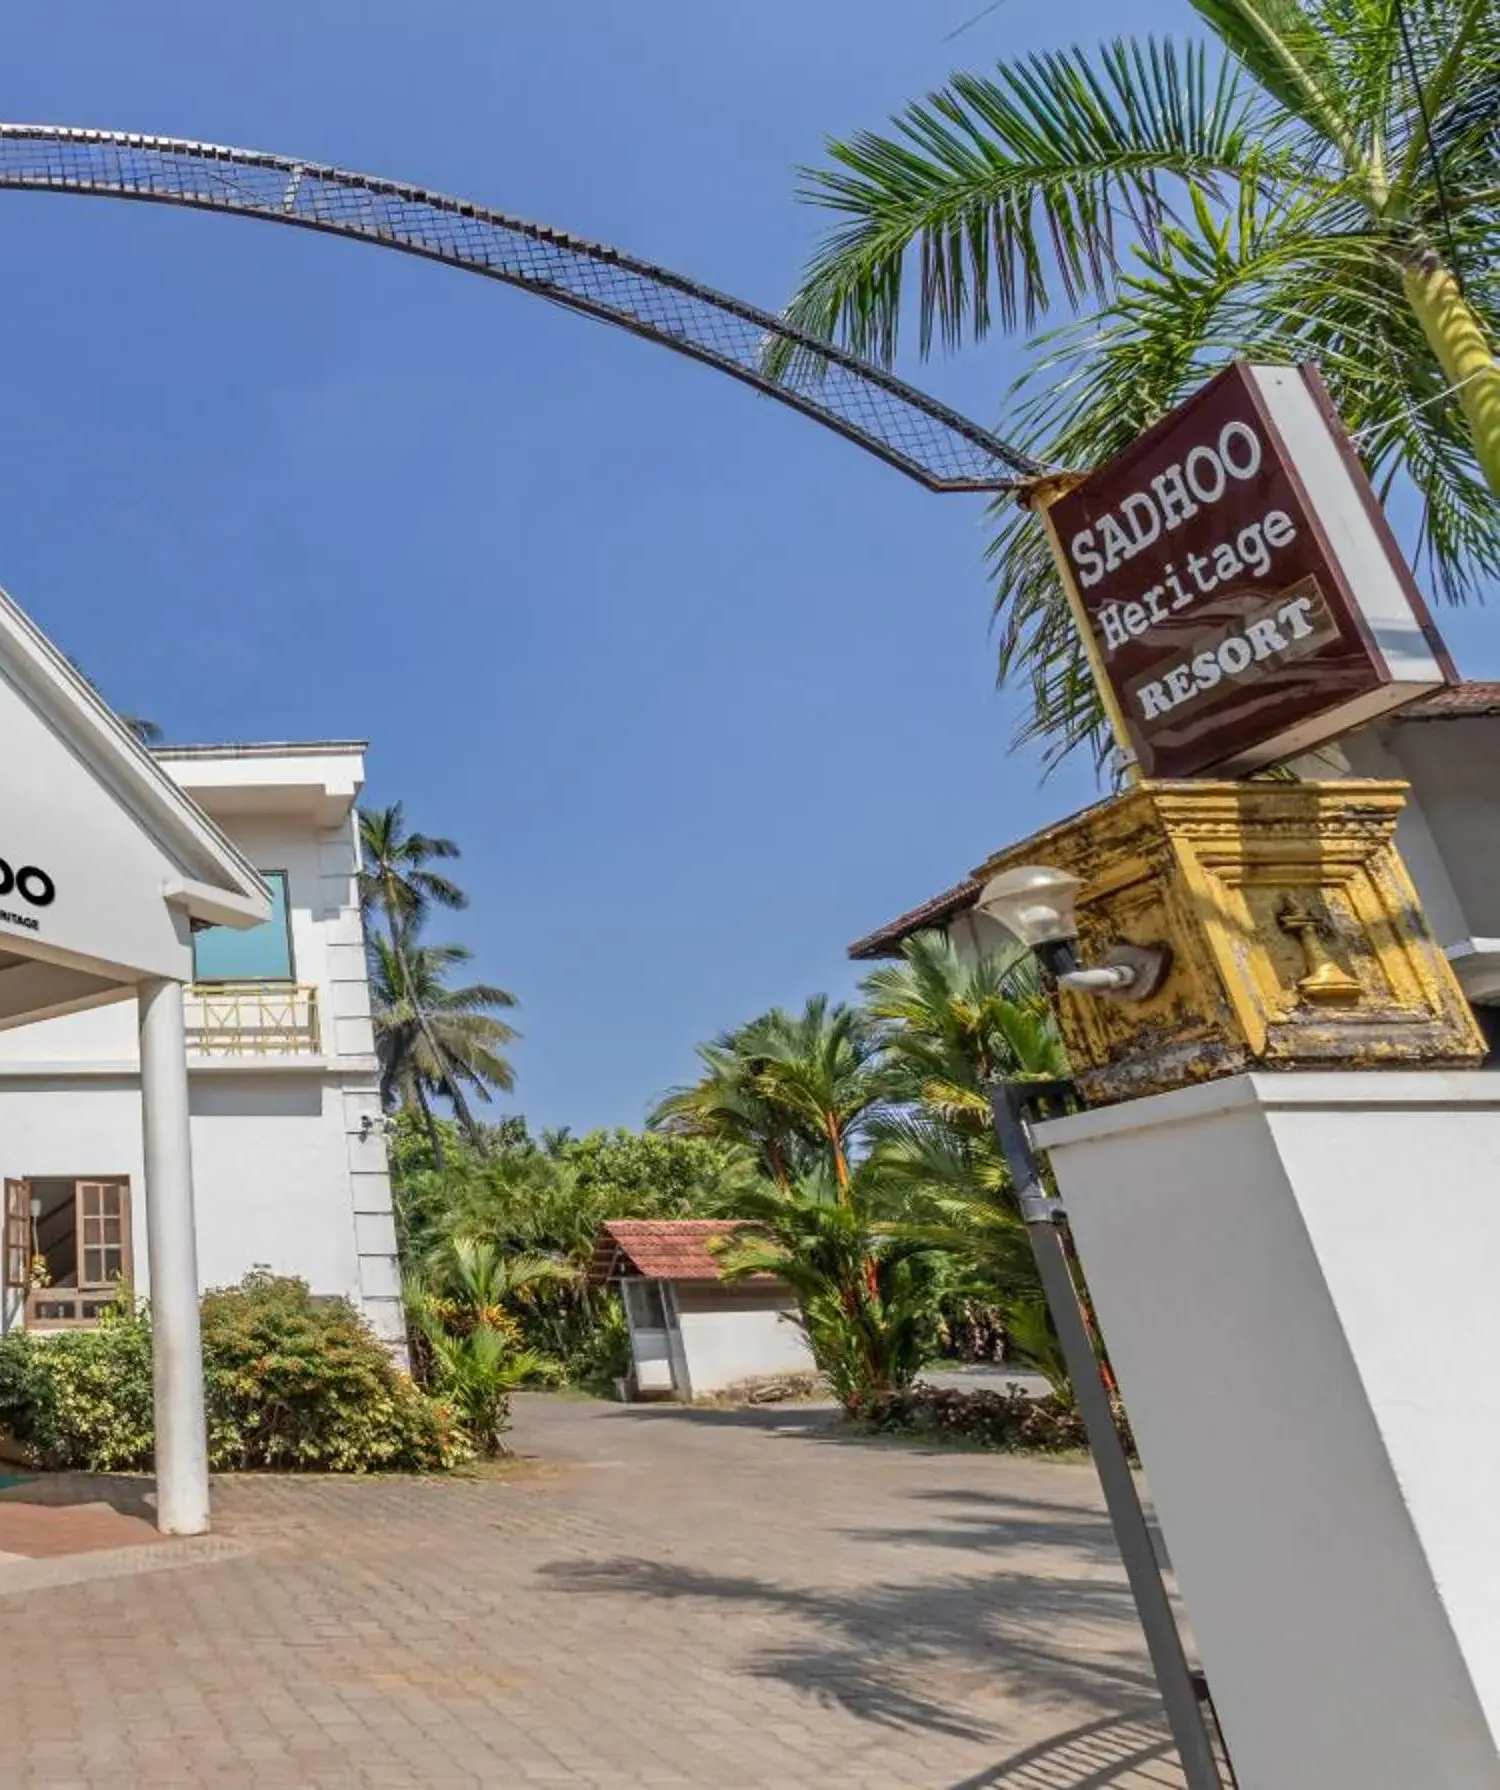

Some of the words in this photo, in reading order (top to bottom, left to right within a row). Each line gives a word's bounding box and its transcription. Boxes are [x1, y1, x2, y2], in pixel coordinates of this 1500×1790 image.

[1071, 421, 1261, 588] SADHOO
[1098, 510, 1297, 652] Heritage
[1136, 597, 1313, 720] RESORT
